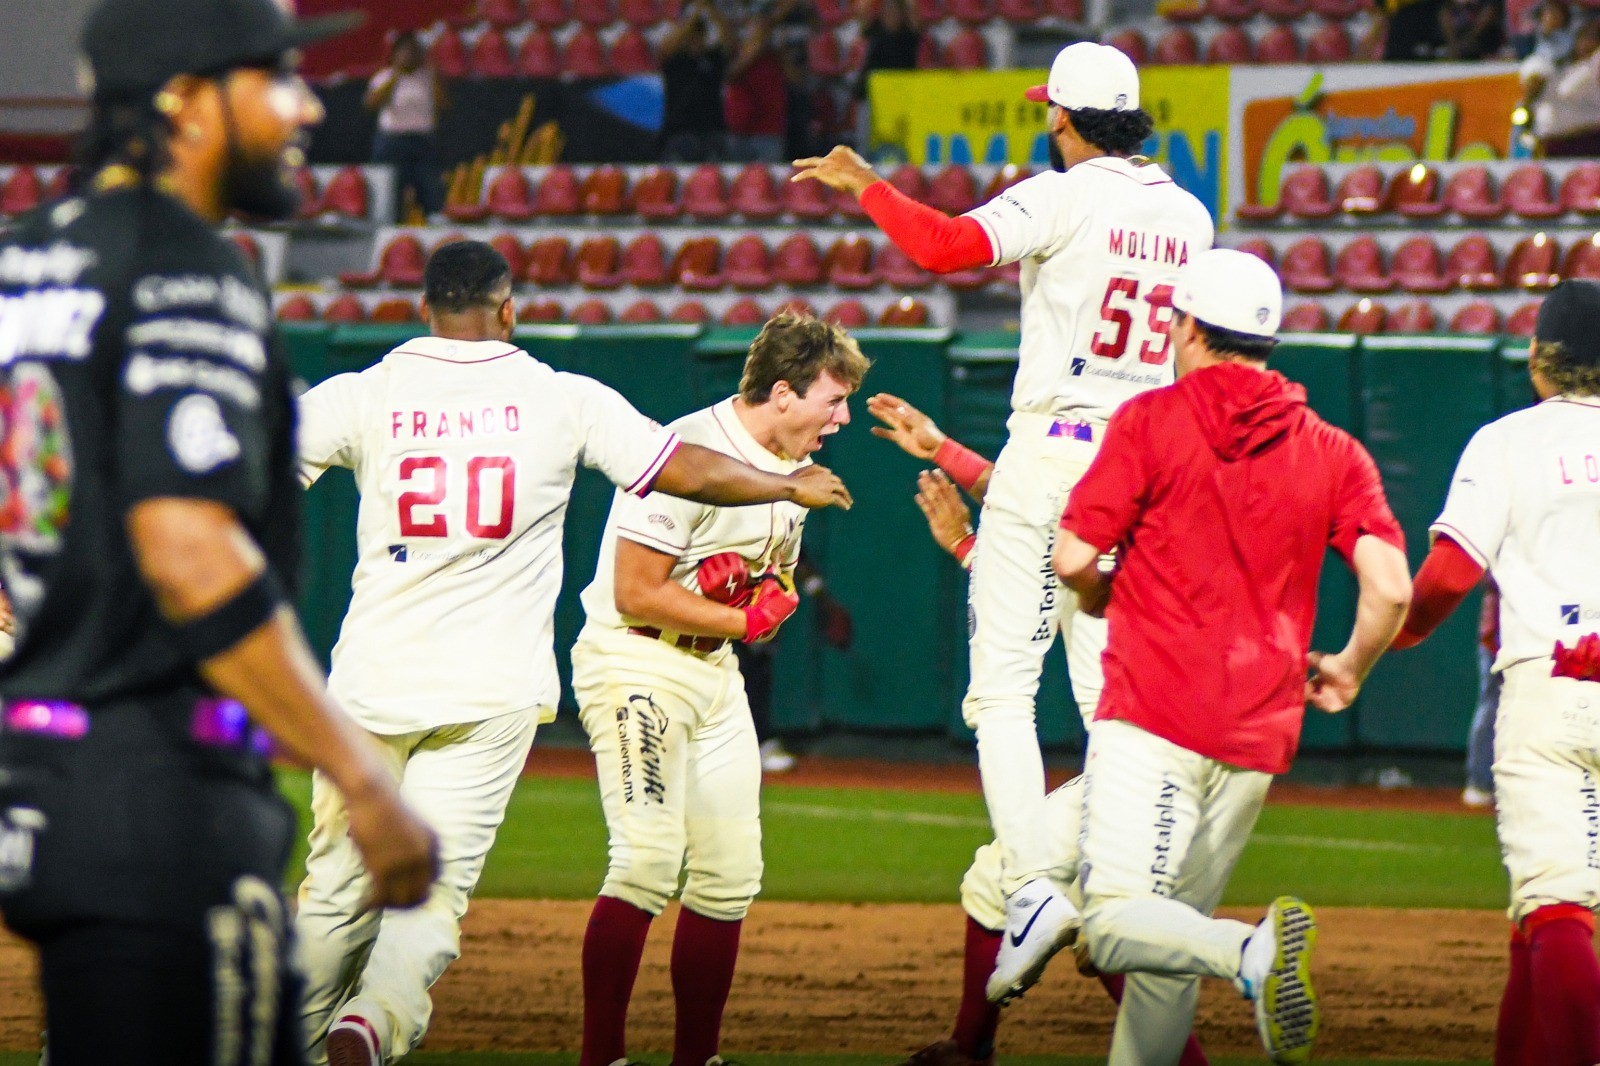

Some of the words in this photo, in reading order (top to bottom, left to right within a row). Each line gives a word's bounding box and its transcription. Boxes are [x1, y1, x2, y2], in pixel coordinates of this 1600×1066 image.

[1109, 228, 1189, 268] MOLINA
[1090, 277, 1175, 367] 59
[392, 405, 520, 439] FRANCO
[398, 456, 516, 540] 20
